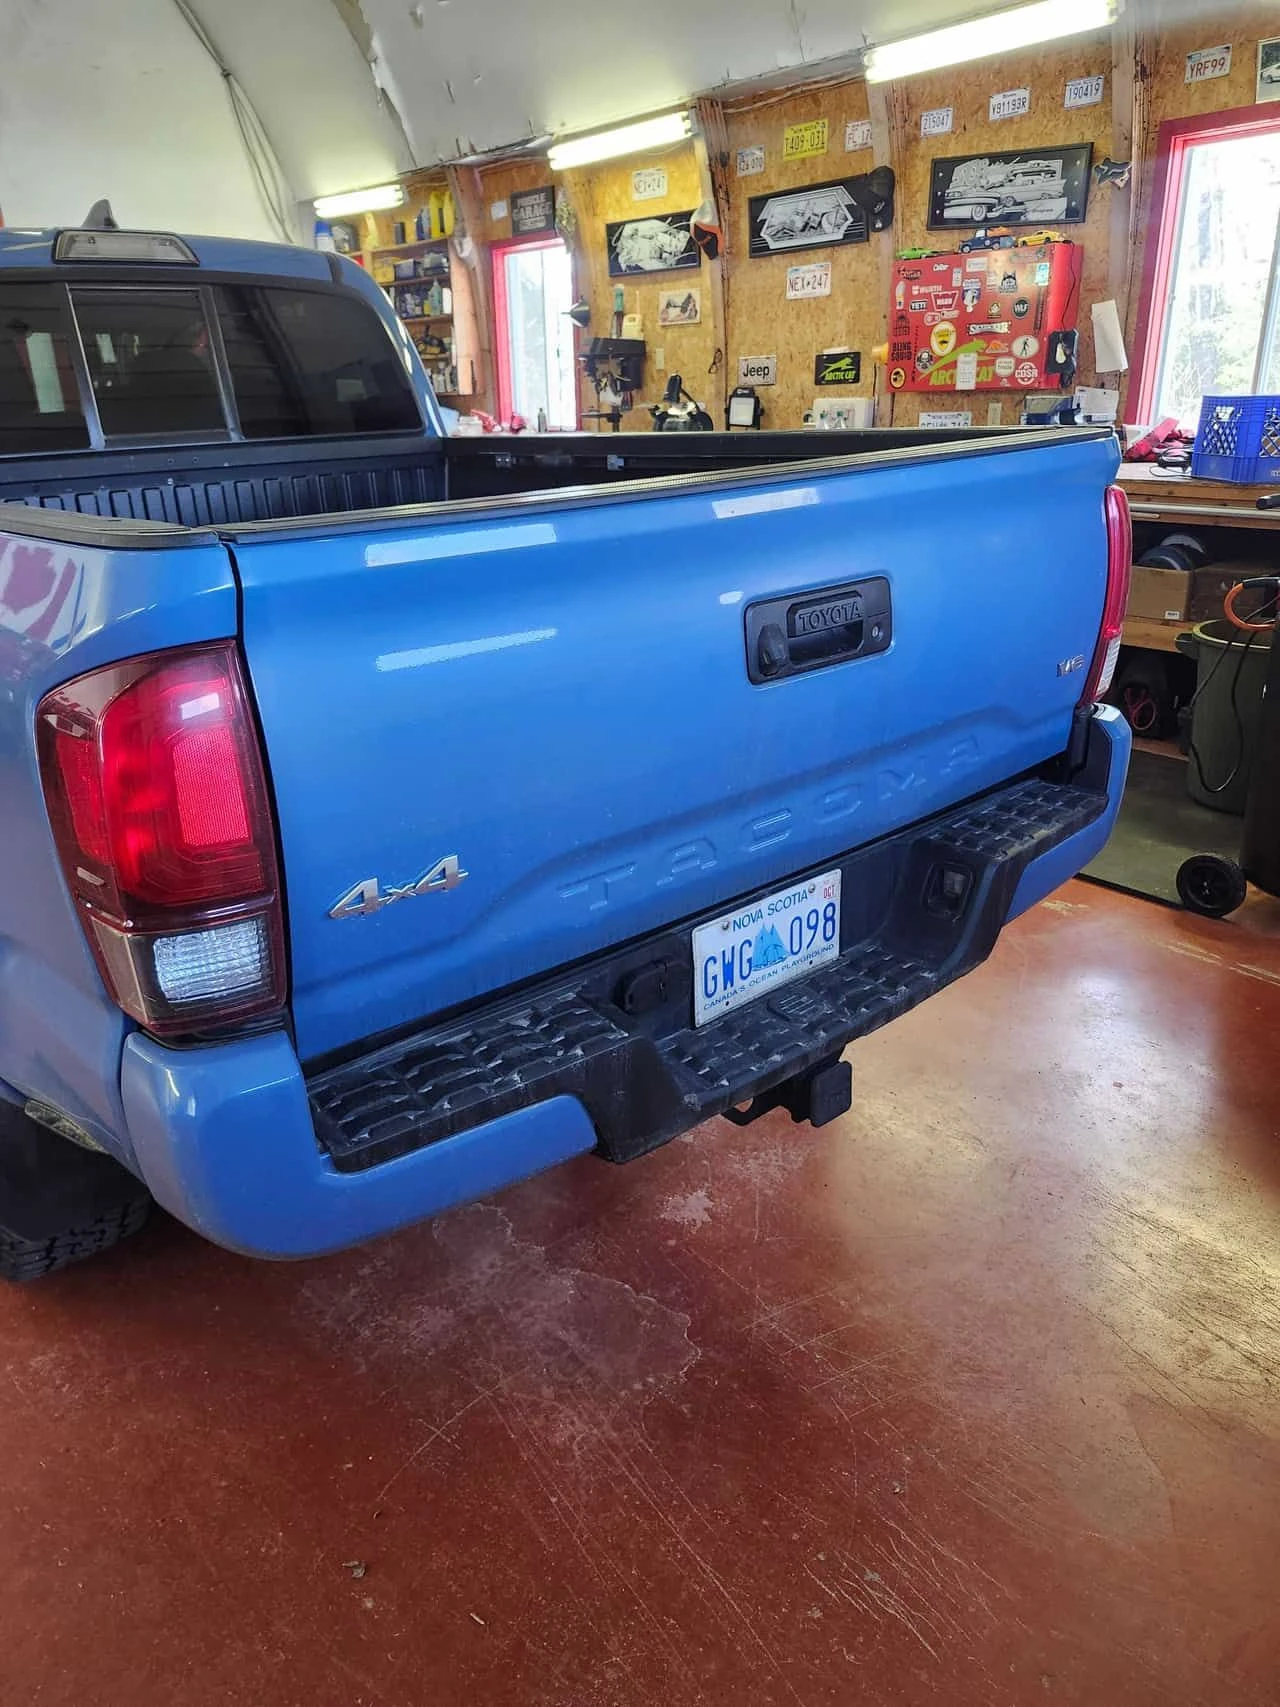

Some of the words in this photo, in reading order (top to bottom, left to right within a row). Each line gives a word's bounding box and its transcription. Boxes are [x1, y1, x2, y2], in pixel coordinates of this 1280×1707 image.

[1189, 57, 1226, 78] YRF99
[742, 363, 770, 379] Jeep
[799, 601, 862, 631] TOYOTA
[559, 734, 983, 911] TACOMA
[732, 908, 764, 932] NOVA
[767, 889, 808, 917] SCOTIA
[703, 939, 753, 999] GWG
[790, 902, 836, 956] 098
[703, 984, 746, 1011] CANADA'S
[749, 970, 778, 988] OCEAN
[781, 943, 835, 971] PLAYGROUND
